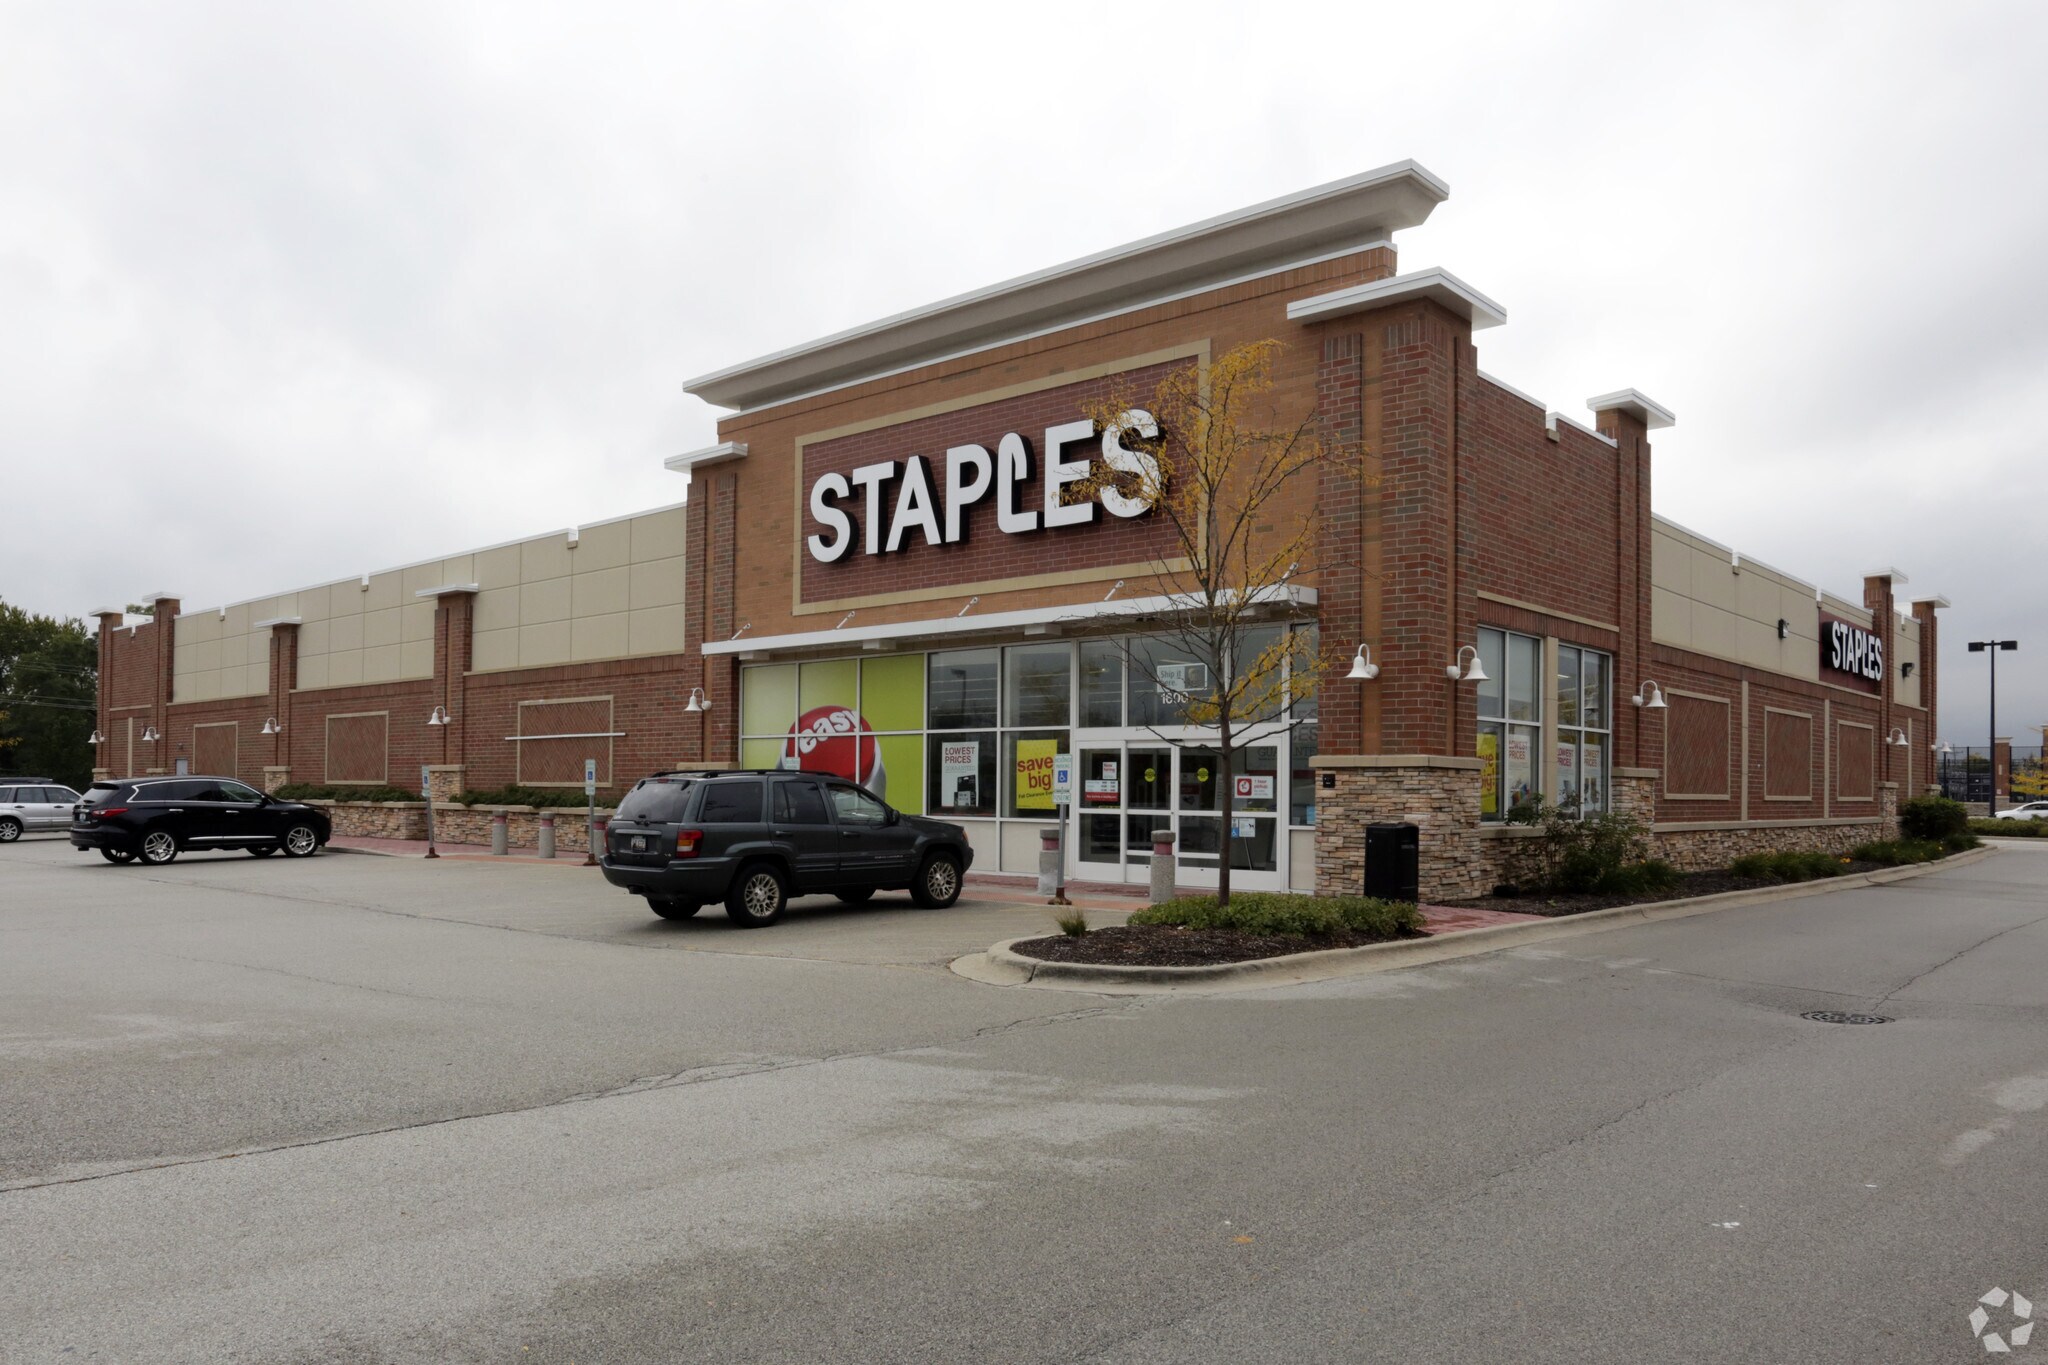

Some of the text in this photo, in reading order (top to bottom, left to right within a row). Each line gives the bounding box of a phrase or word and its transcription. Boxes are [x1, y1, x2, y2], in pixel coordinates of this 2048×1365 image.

[807, 408, 1163, 563] STAPLES
[1831, 620, 1883, 681] STAPLES
[1160, 670, 1175, 680] Ship
[799, 710, 863, 754] easy
[944, 746, 976, 756] LOWEST
[1508, 750, 1526, 760] PRICES
[944, 755, 972, 764] PRICES
[1017, 756, 1054, 773] save
